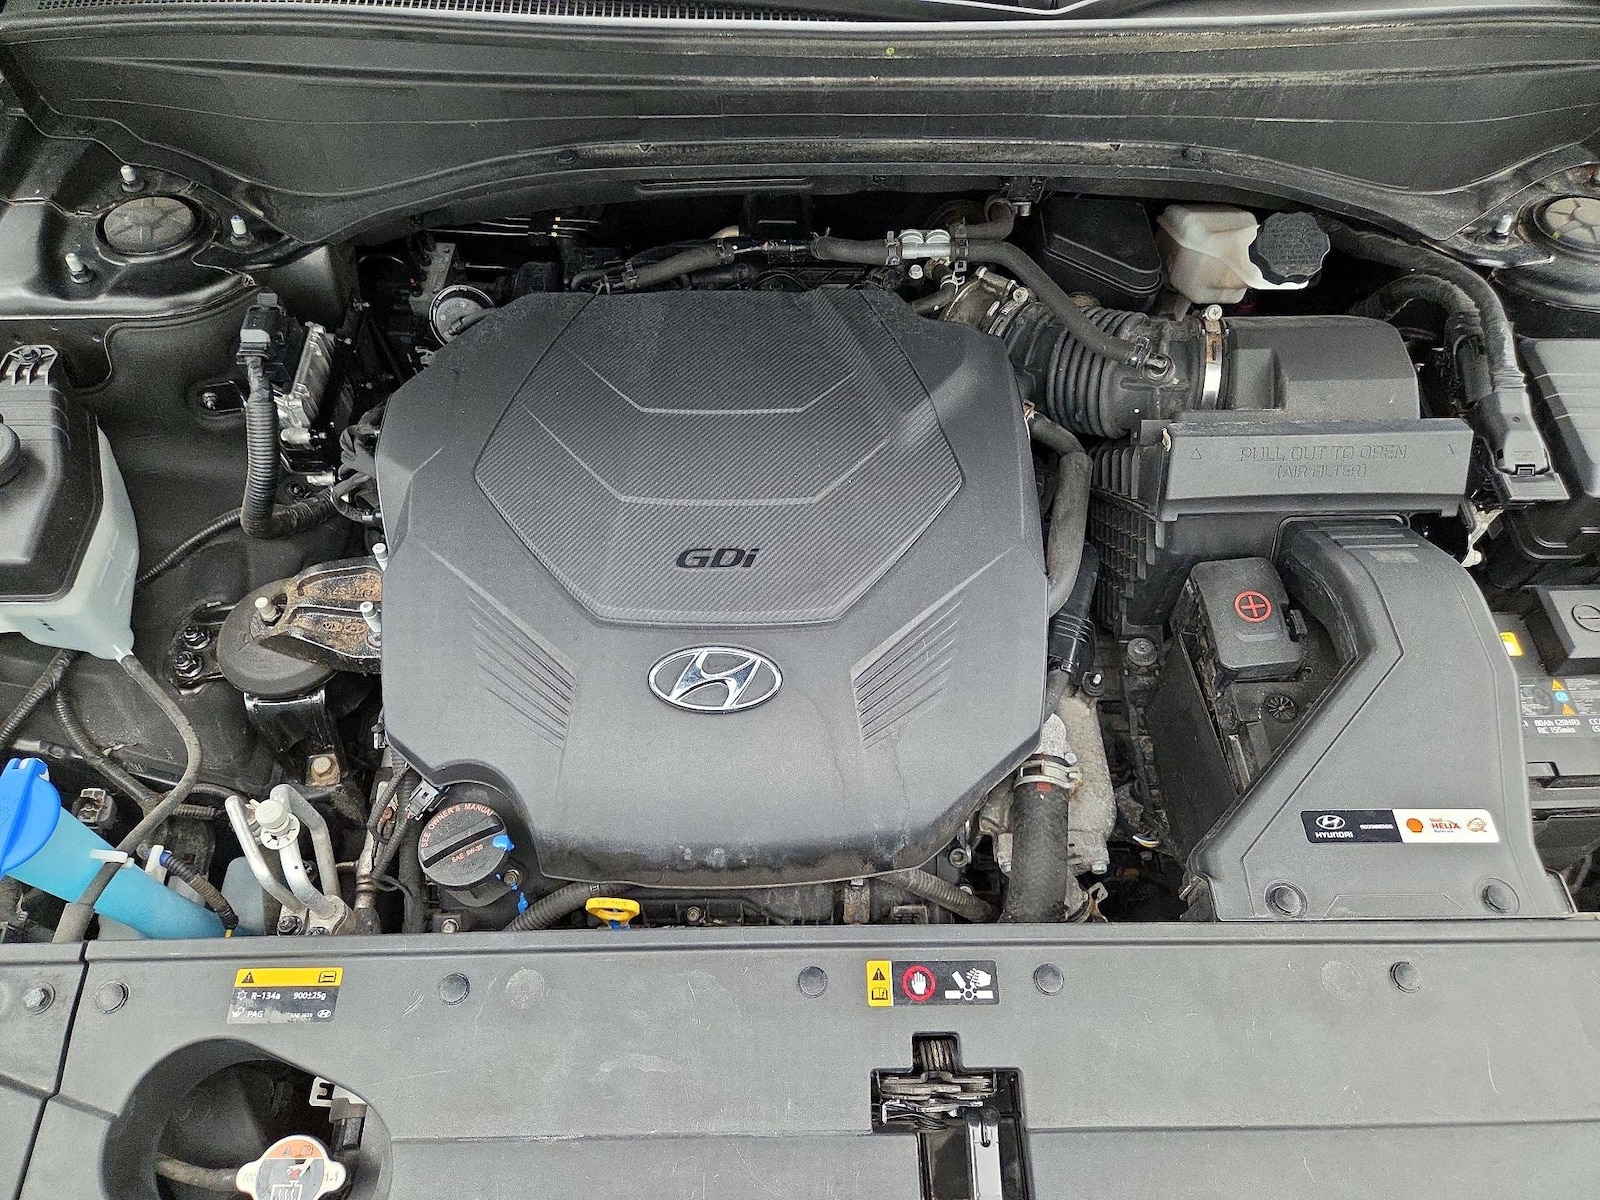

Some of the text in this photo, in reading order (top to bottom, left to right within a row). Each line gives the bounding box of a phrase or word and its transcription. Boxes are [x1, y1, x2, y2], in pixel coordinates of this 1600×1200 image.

[1240, 444, 1408, 462] PULL OUT TO OPEN
[676, 548, 760, 568] GDi
[421, 832, 431, 848] SEE
[428, 804, 461, 830] OWNER'S
[451, 853, 464, 863] SAE
[251, 992, 327, 1001] R-134a 900±25g
[246, 1010, 264, 1018] PAG
